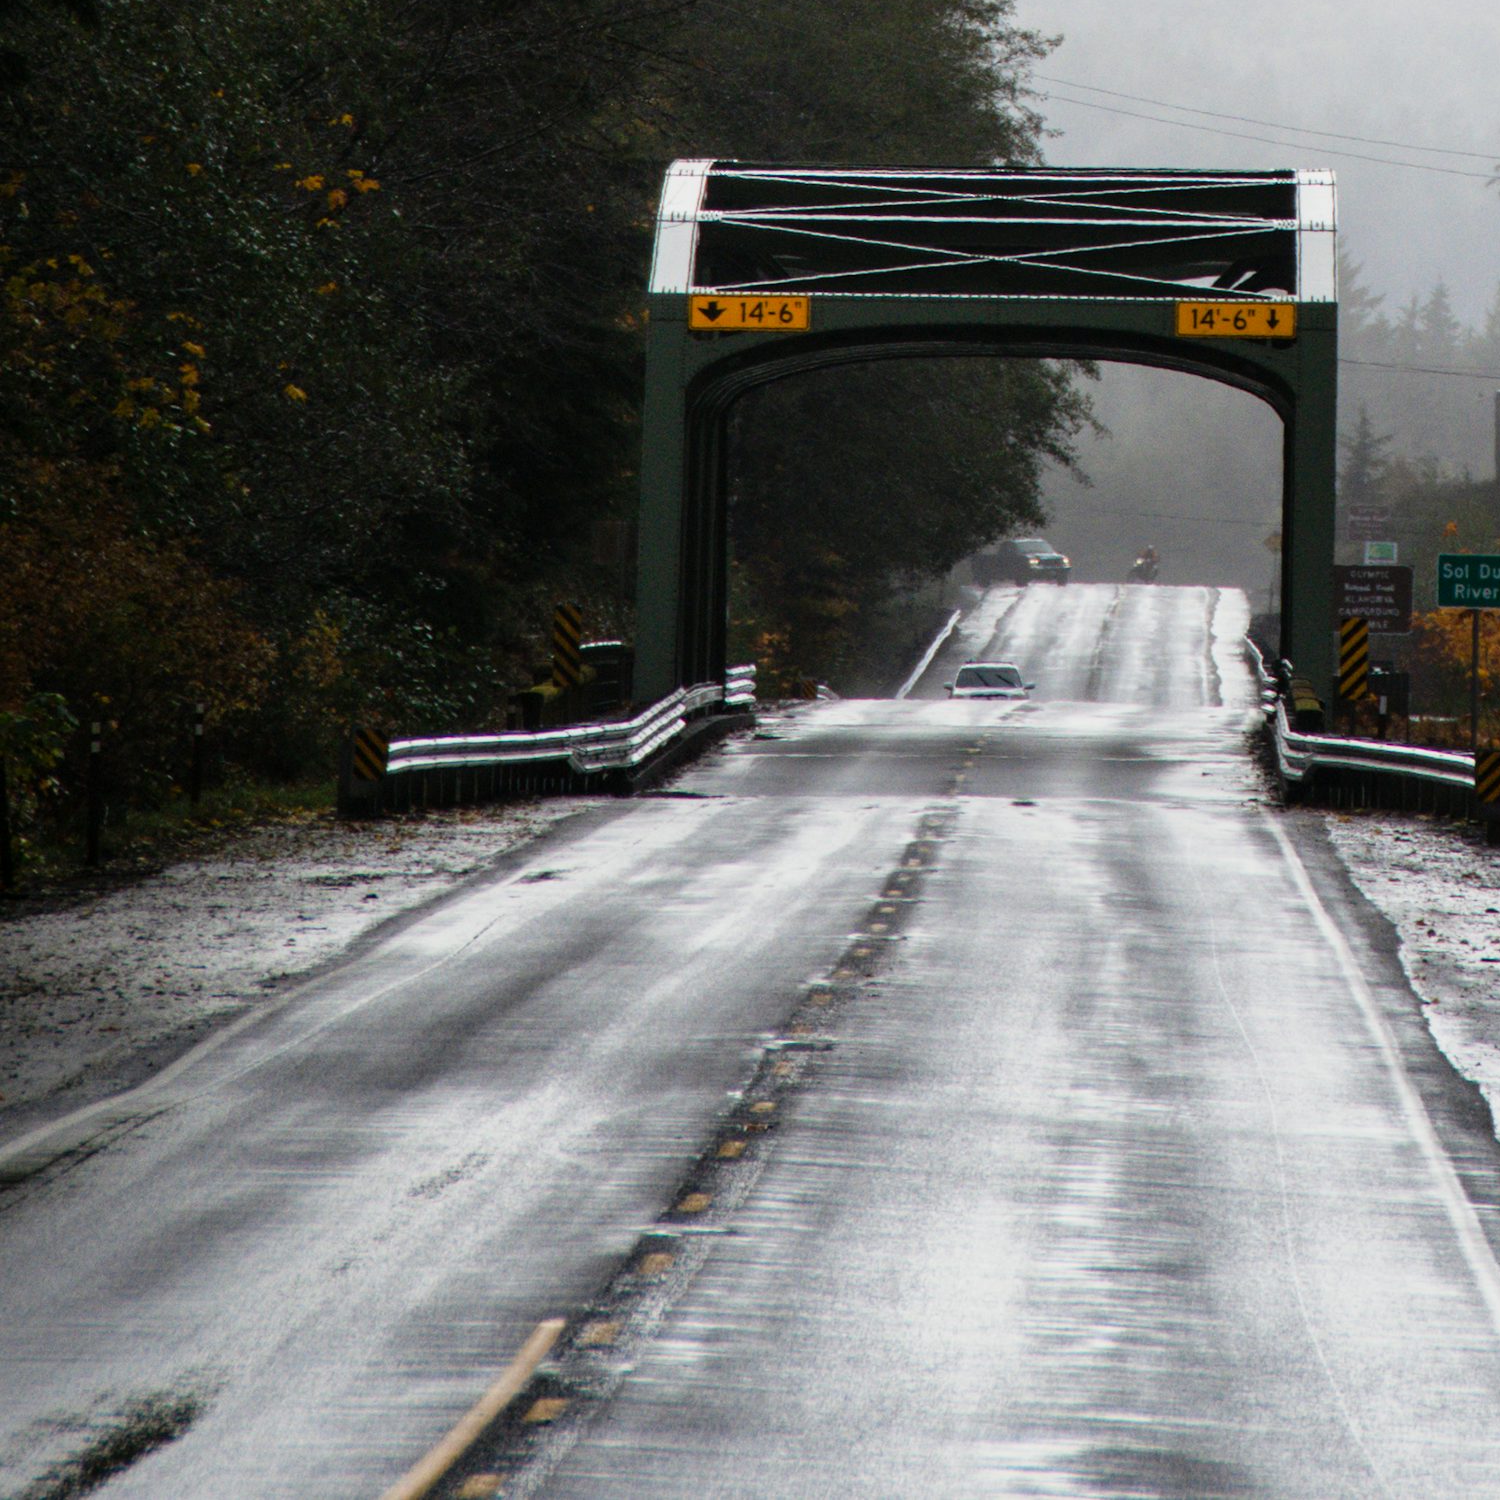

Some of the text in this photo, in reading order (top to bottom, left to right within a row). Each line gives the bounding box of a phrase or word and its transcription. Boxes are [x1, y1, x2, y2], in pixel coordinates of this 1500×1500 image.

[740, 300, 802, 323] 14'-6"
[1191, 308, 1255, 330] 14'-6"
[1443, 562, 1470, 579] Sol
[1454, 583, 1500, 600] River
